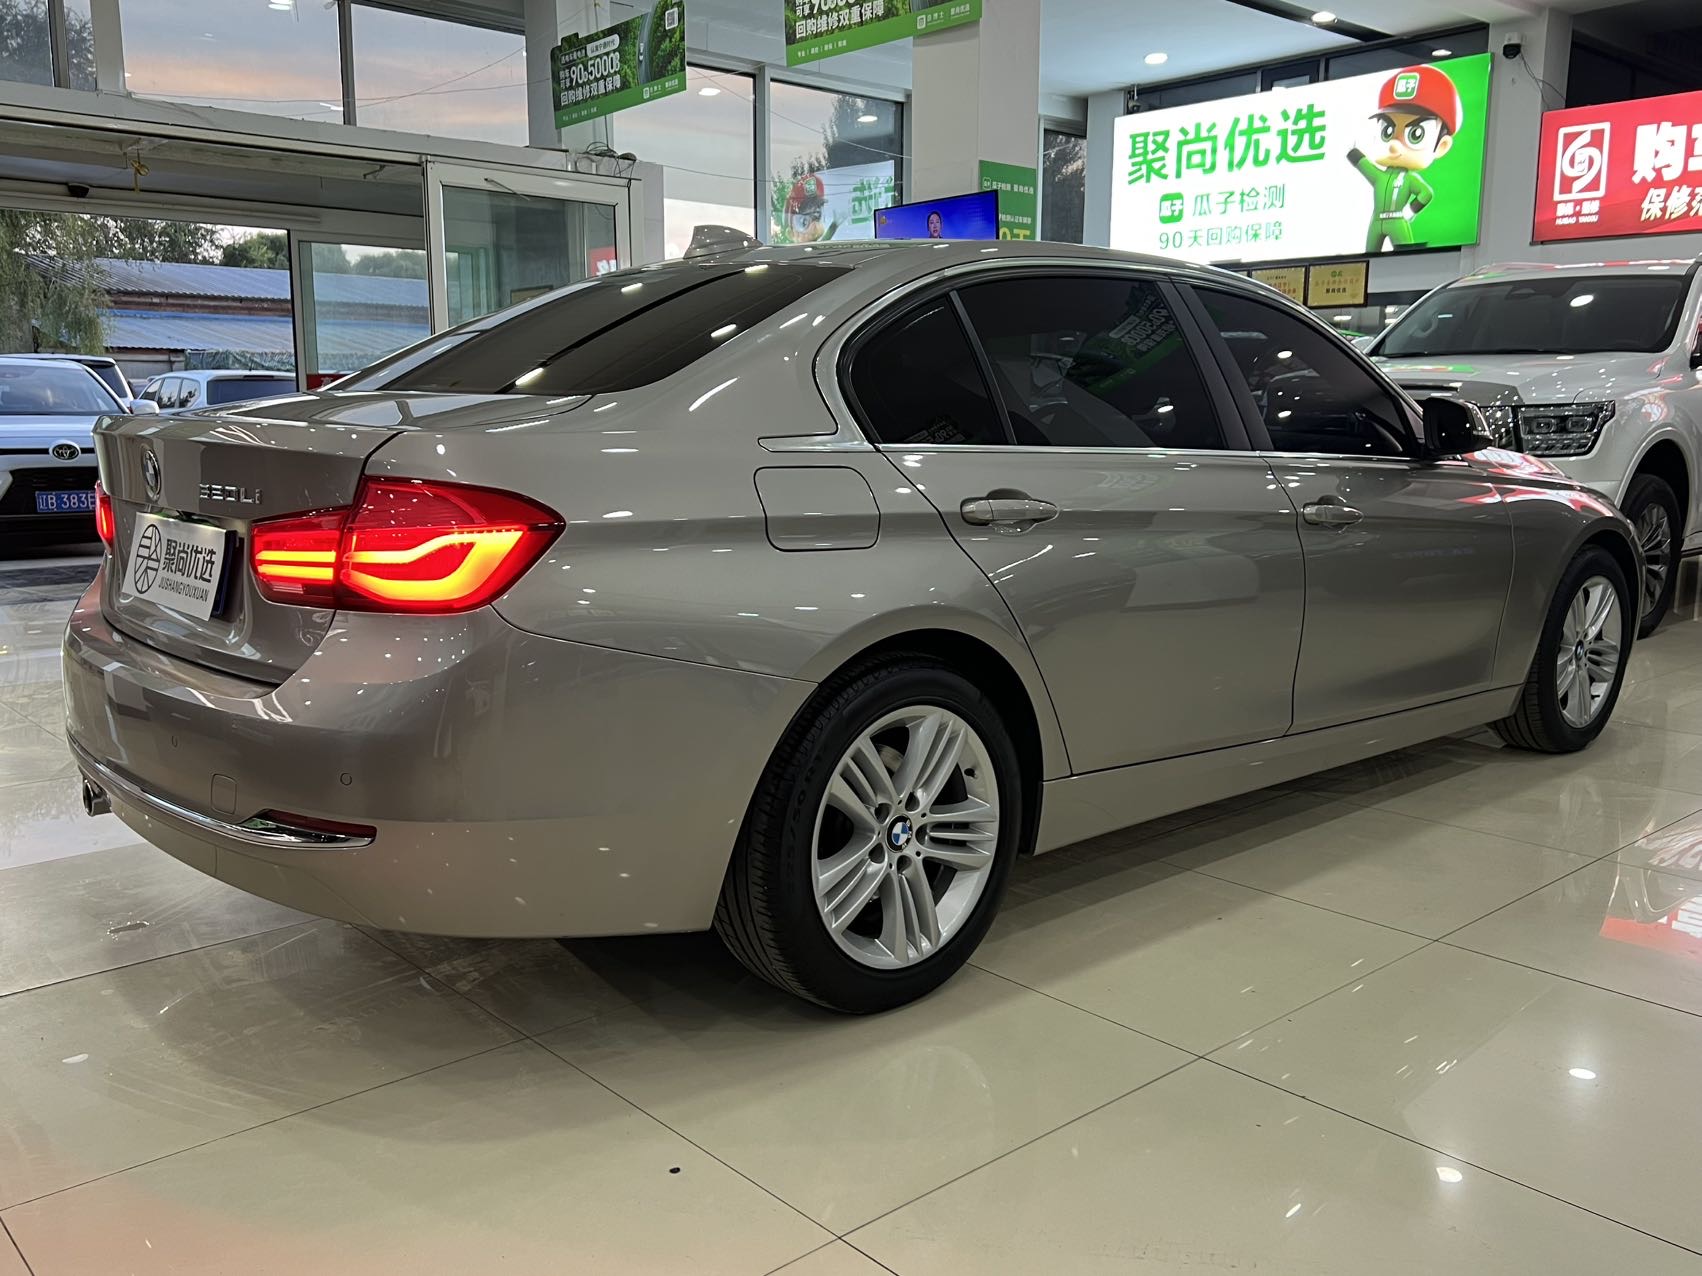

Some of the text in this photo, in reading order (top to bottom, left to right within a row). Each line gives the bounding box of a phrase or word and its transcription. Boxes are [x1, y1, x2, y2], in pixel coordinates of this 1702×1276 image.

[796, 0, 885, 38] 回购维修双重保障
[561, 74, 621, 106] 回购维修双重保障
[1128, 104, 1327, 185] 聚尚优选
[1631, 121, 1702, 185] 购
[1192, 184, 1286, 217] 瓜子检测
[1158, 221, 1283, 250] 90天回购保障
[161, 538, 217, 584] 聚尚优选
[158, 577, 211, 602] JUSHANGYOUXUAN
